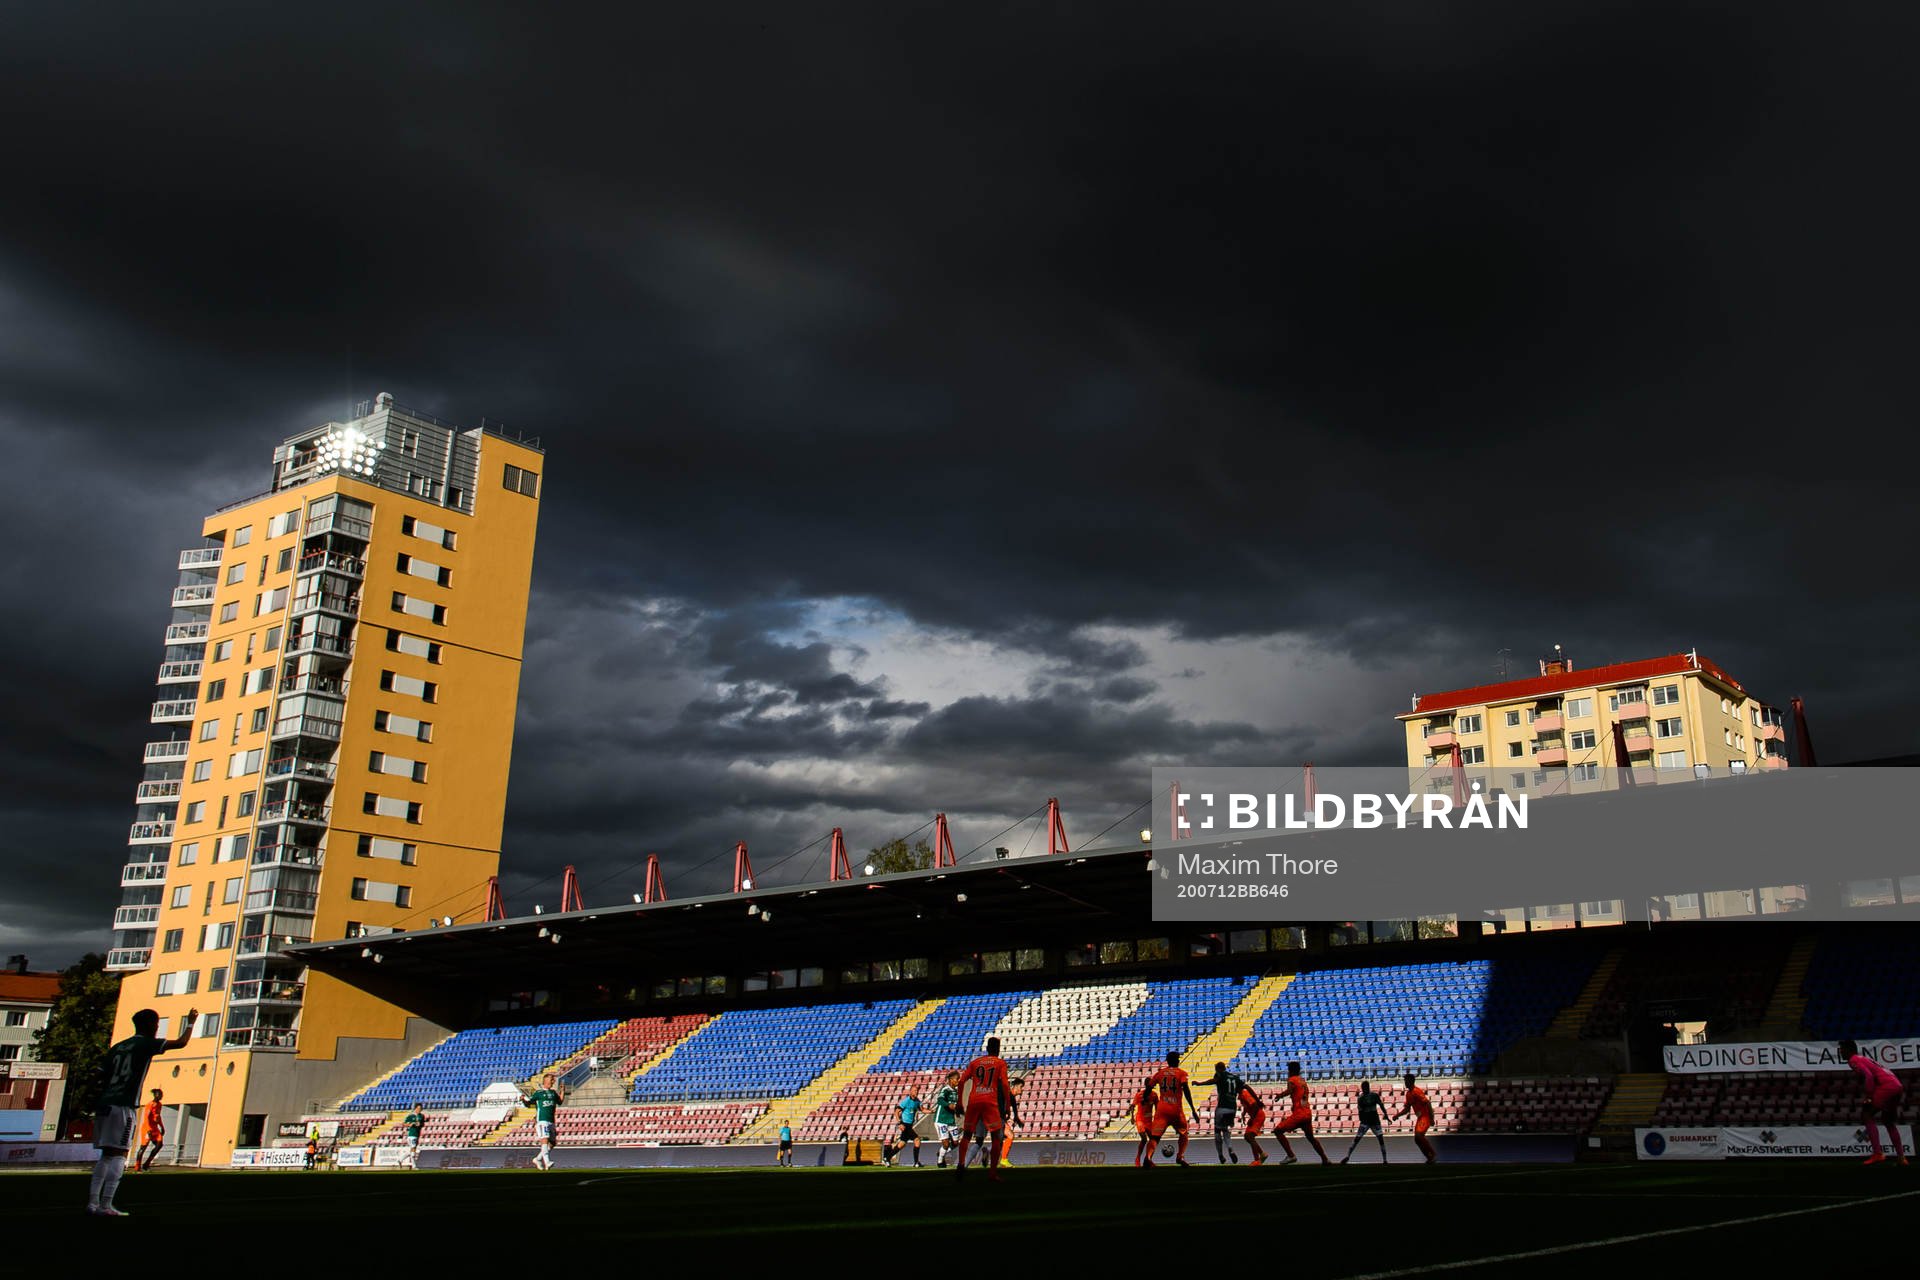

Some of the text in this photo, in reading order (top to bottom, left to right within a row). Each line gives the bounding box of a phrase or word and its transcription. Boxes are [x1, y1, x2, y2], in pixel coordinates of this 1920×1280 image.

[1669, 1047, 1787, 1069] LADINGEN
[976, 1065, 996, 1088] 91
[1226, 1079, 1237, 1093] 11
[1727, 1145, 1812, 1154] MaxFASTIGHETER
[265, 1151, 300, 1164] Hisstech
